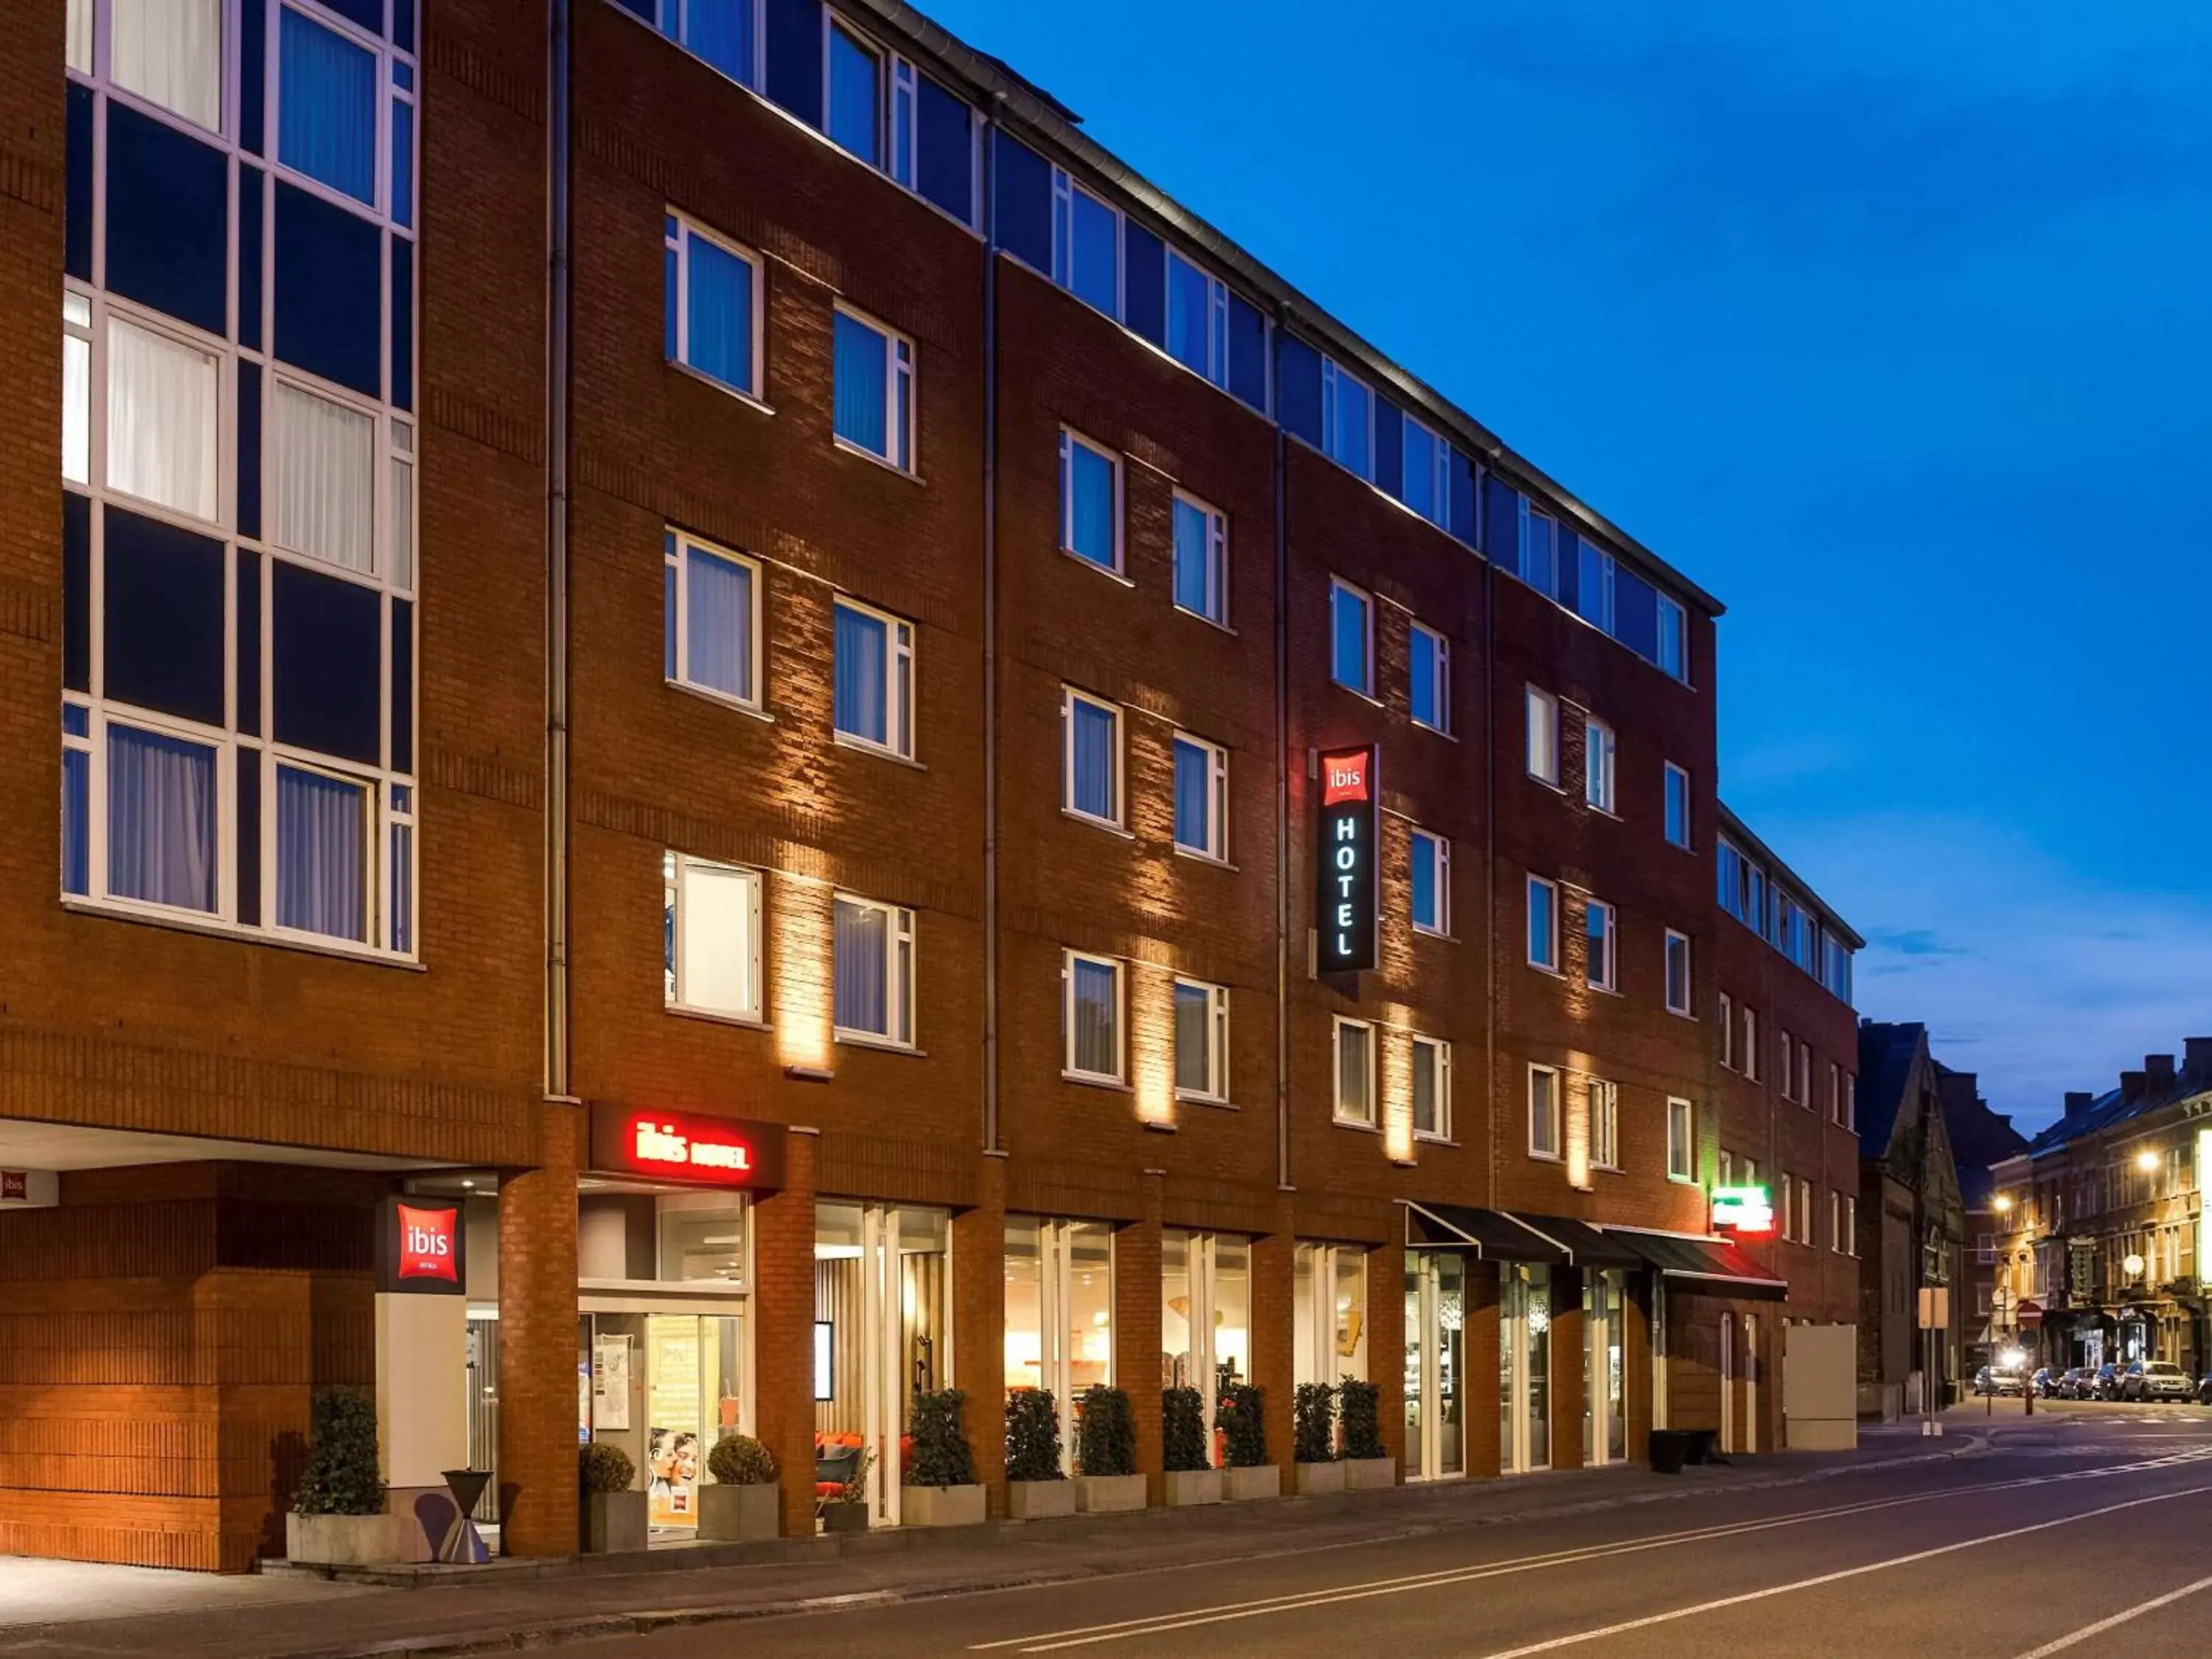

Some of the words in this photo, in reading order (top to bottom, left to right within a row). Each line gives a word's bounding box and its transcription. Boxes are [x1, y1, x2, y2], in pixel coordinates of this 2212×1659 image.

[1330, 767, 1360, 788] ibis
[1337, 817, 1355, 956] HOTEL
[636, 1121, 687, 1163] ibis
[408, 1226, 448, 1256] ibis
